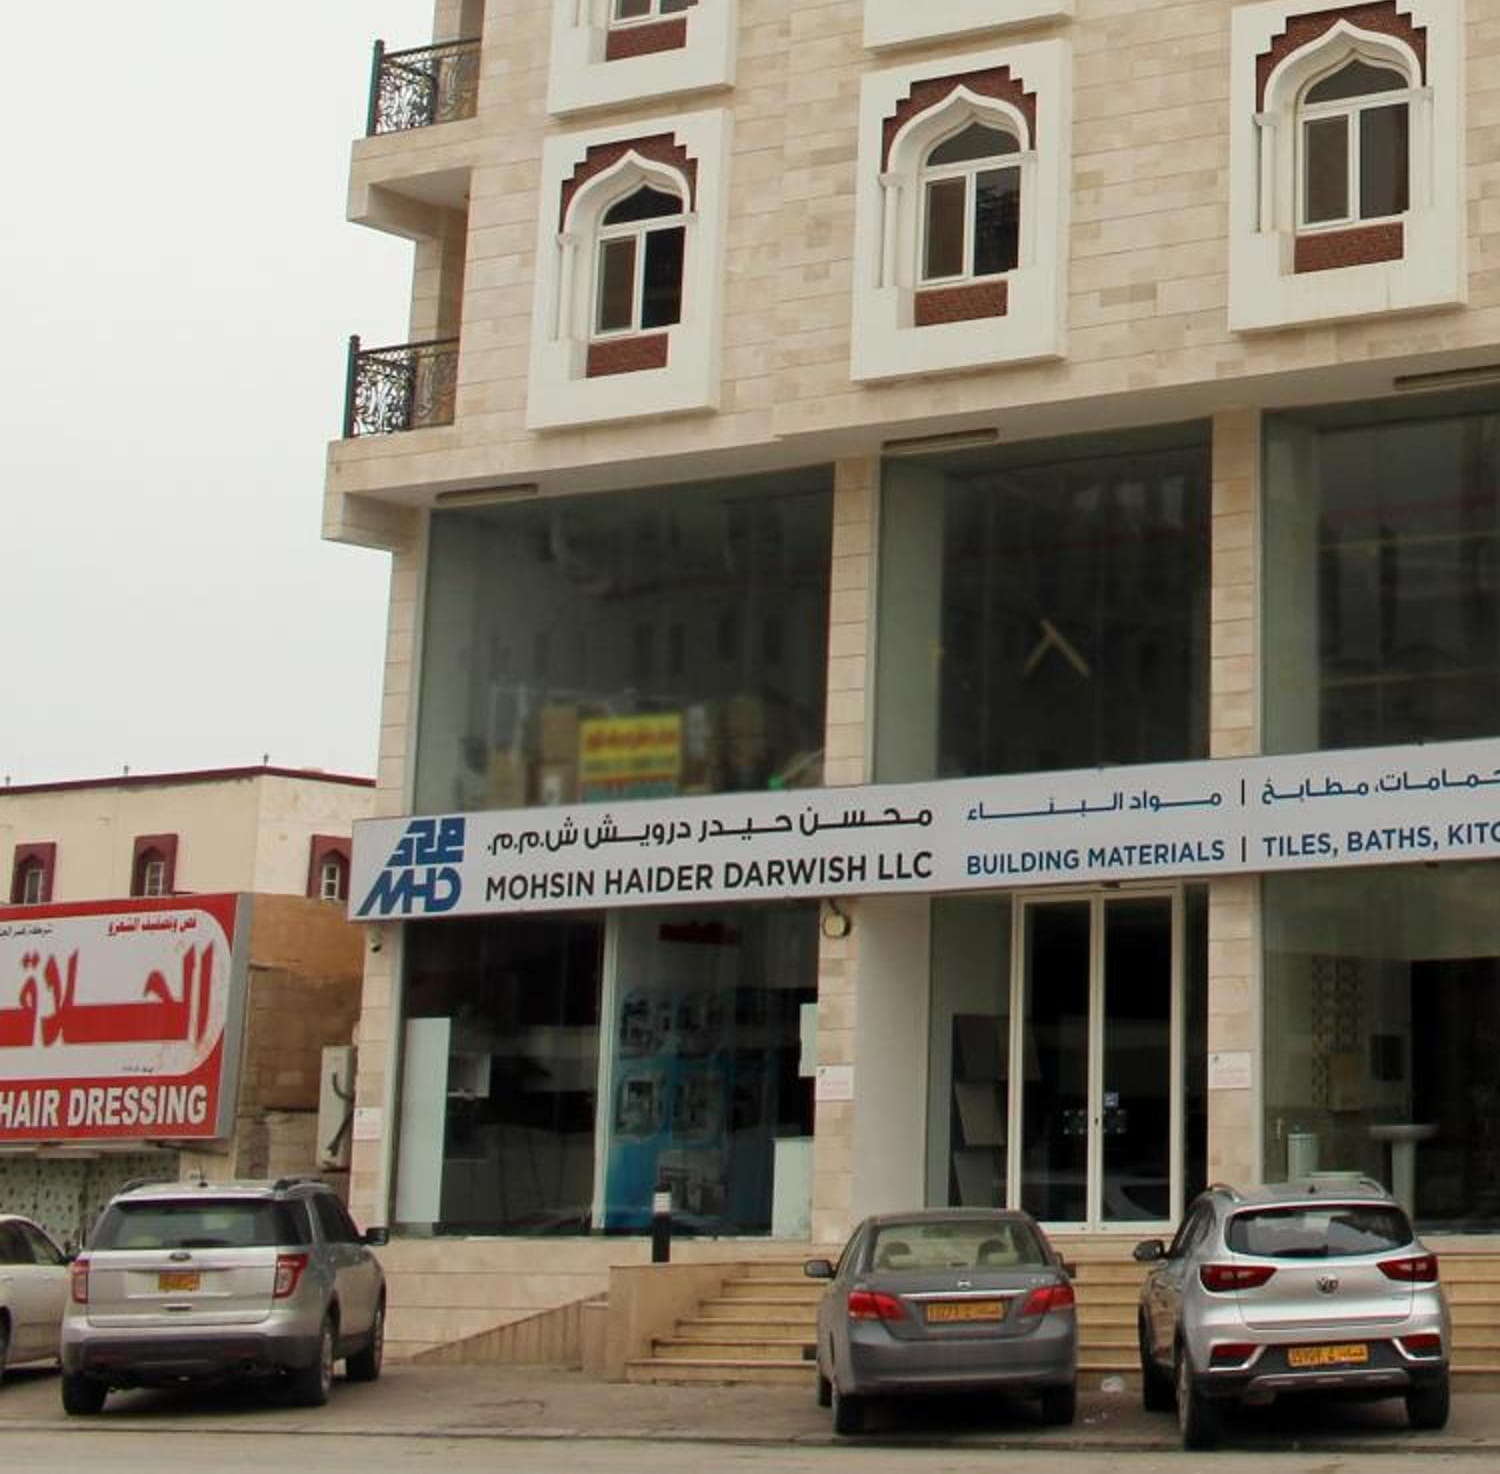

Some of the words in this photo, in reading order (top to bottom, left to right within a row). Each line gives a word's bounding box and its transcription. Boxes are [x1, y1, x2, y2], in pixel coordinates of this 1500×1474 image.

[967, 791, 1123, 821] البناء
[1130, 790, 1222, 812] مواد
[1261, 777, 1369, 805] مطابخ
[584, 814, 692, 849] درويش
[698, 813, 793, 842] حيدر
[800, 807, 933, 837] محسن
[967, 848, 1080, 876] BUILDING
[1088, 840, 1225, 868] MATERIALS
[1263, 832, 1339, 858] TILES,
[1347, 826, 1439, 853] BATHS,
[357, 866, 462, 916] MHD
[486, 869, 594, 902] MOHSIN
[604, 863, 713, 895] HAIDER
[723, 855, 866, 888] DARWISH
[878, 851, 933, 880] LLC
[0, 941, 214, 1047] الحلاق
[0, 1089, 60, 1127] HAIR
[67, 1085, 208, 1127] DRESSING
